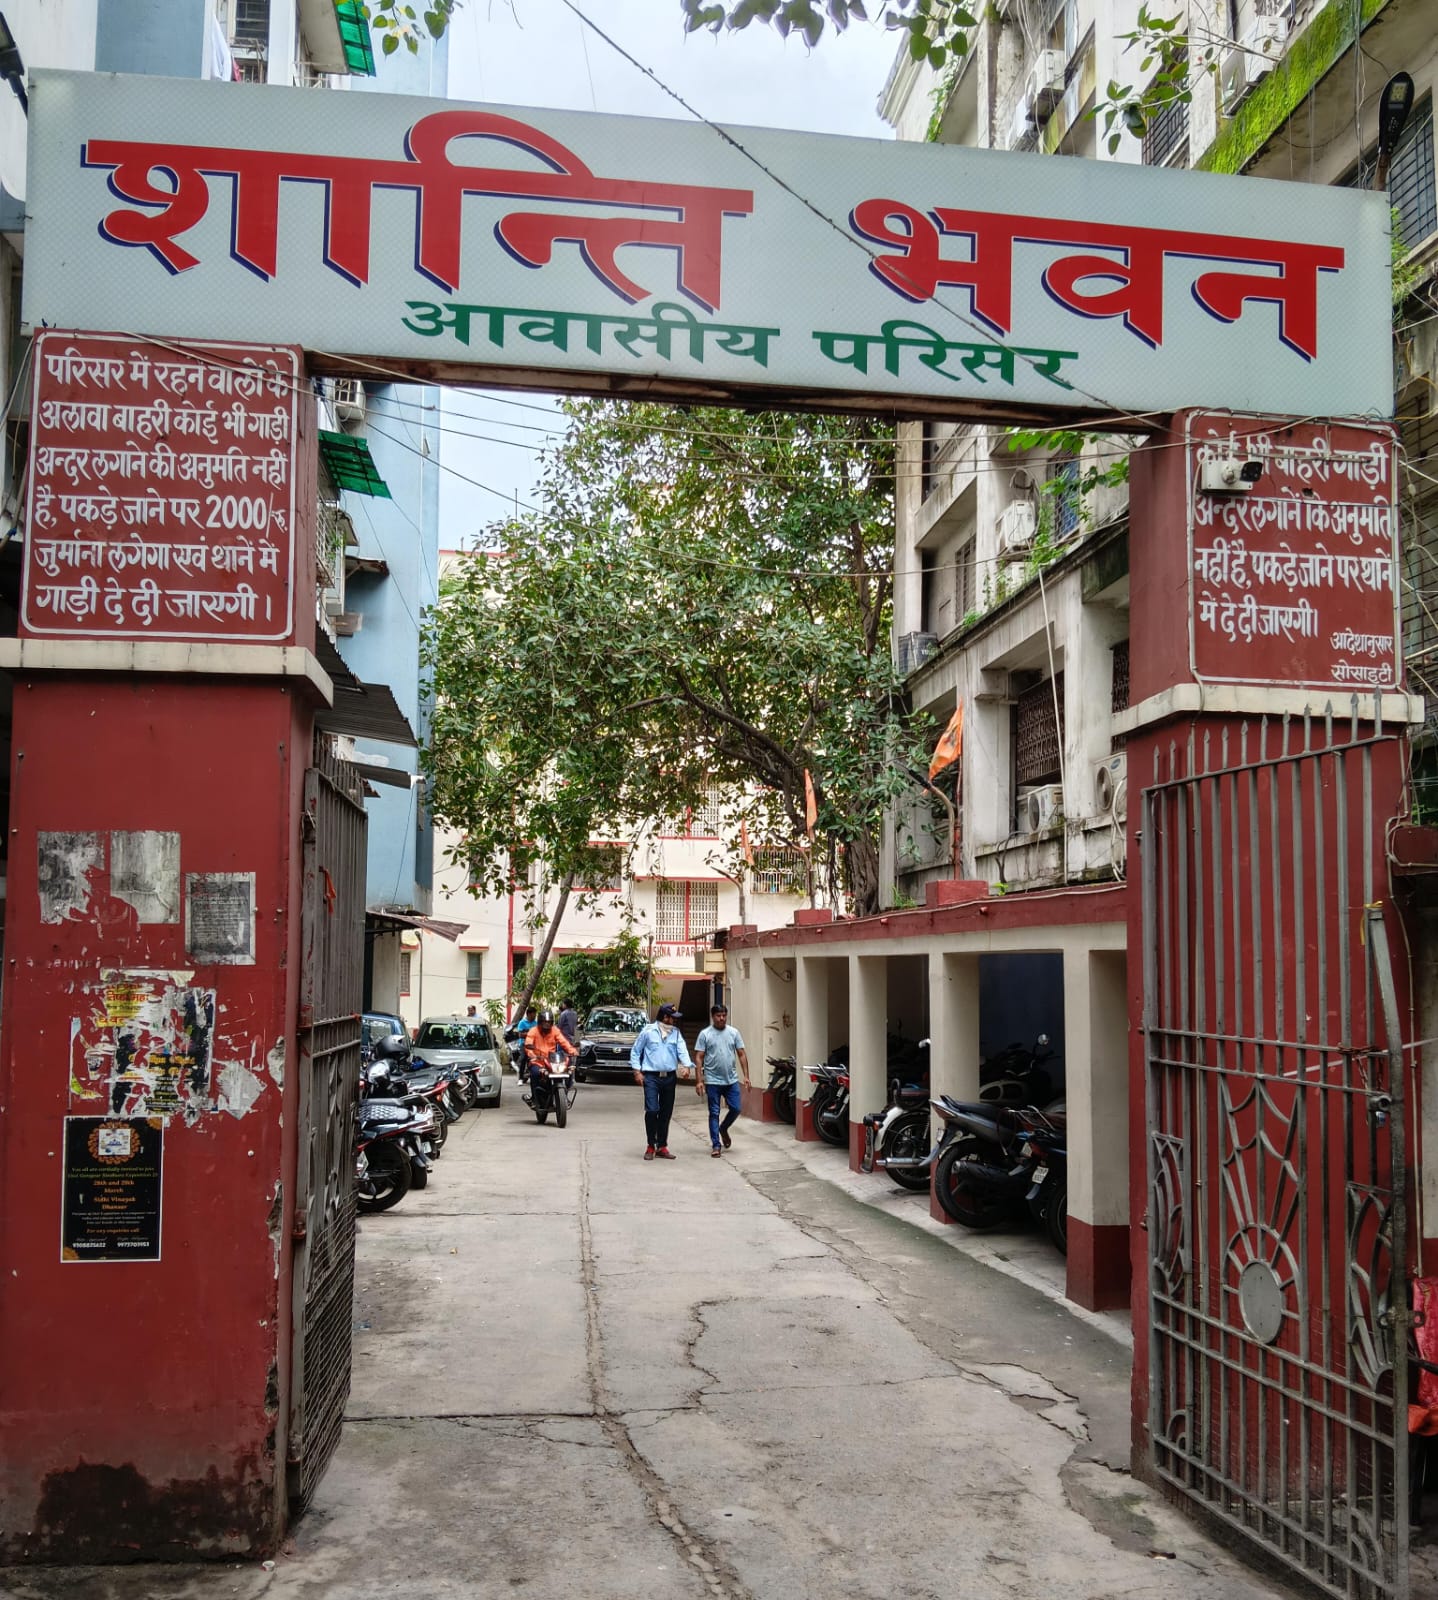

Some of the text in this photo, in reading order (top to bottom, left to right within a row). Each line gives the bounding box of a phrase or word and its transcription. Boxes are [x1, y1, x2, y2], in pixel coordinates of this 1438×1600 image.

[80, 110, 1345, 363] शान्ति भवन
[401, 301, 1079, 391] आवासीय परिसर
[44, 347, 127, 391] परिसर
[128, 351, 152, 391] में
[265, 360, 289, 399] के
[39, 399, 291, 445] अलावा बाहरी कोई भी गाड़ी
[36, 440, 289, 490] अन्दर लगाने की अनुमति नहीं
[1275, 437, 1331, 484] बाहरी
[1333, 442, 1389, 490] गाड़ी
[35, 484, 57, 529] है,
[58, 485, 120, 530] पकड़े
[120, 487, 168, 526] जाने
[168, 498, 205, 529] पर
[1195, 496, 1252, 534] अन्दर
[1330, 495, 1392, 545] अनुमति
[34, 529, 108, 577] जुर्माना
[108, 532, 172, 573] लगेगा
[258, 539, 281, 576] में
[1195, 537, 1232, 588] नहीं
[1248, 542, 1299, 593] पकड़े
[1298, 543, 1334, 588] जाने
[1334, 555, 1364, 593] पर
[35, 575, 101, 622] गाड़ी
[104, 577, 127, 625] दे
[128, 578, 163, 626] दी
[1198, 590, 1218, 632] में
[1220, 592, 1238, 642] दे
[1238, 594, 1260, 643] दी
[1330, 627, 1394, 657] आदेशानुसार
[1330, 659, 1392, 683] सोसाइटी
